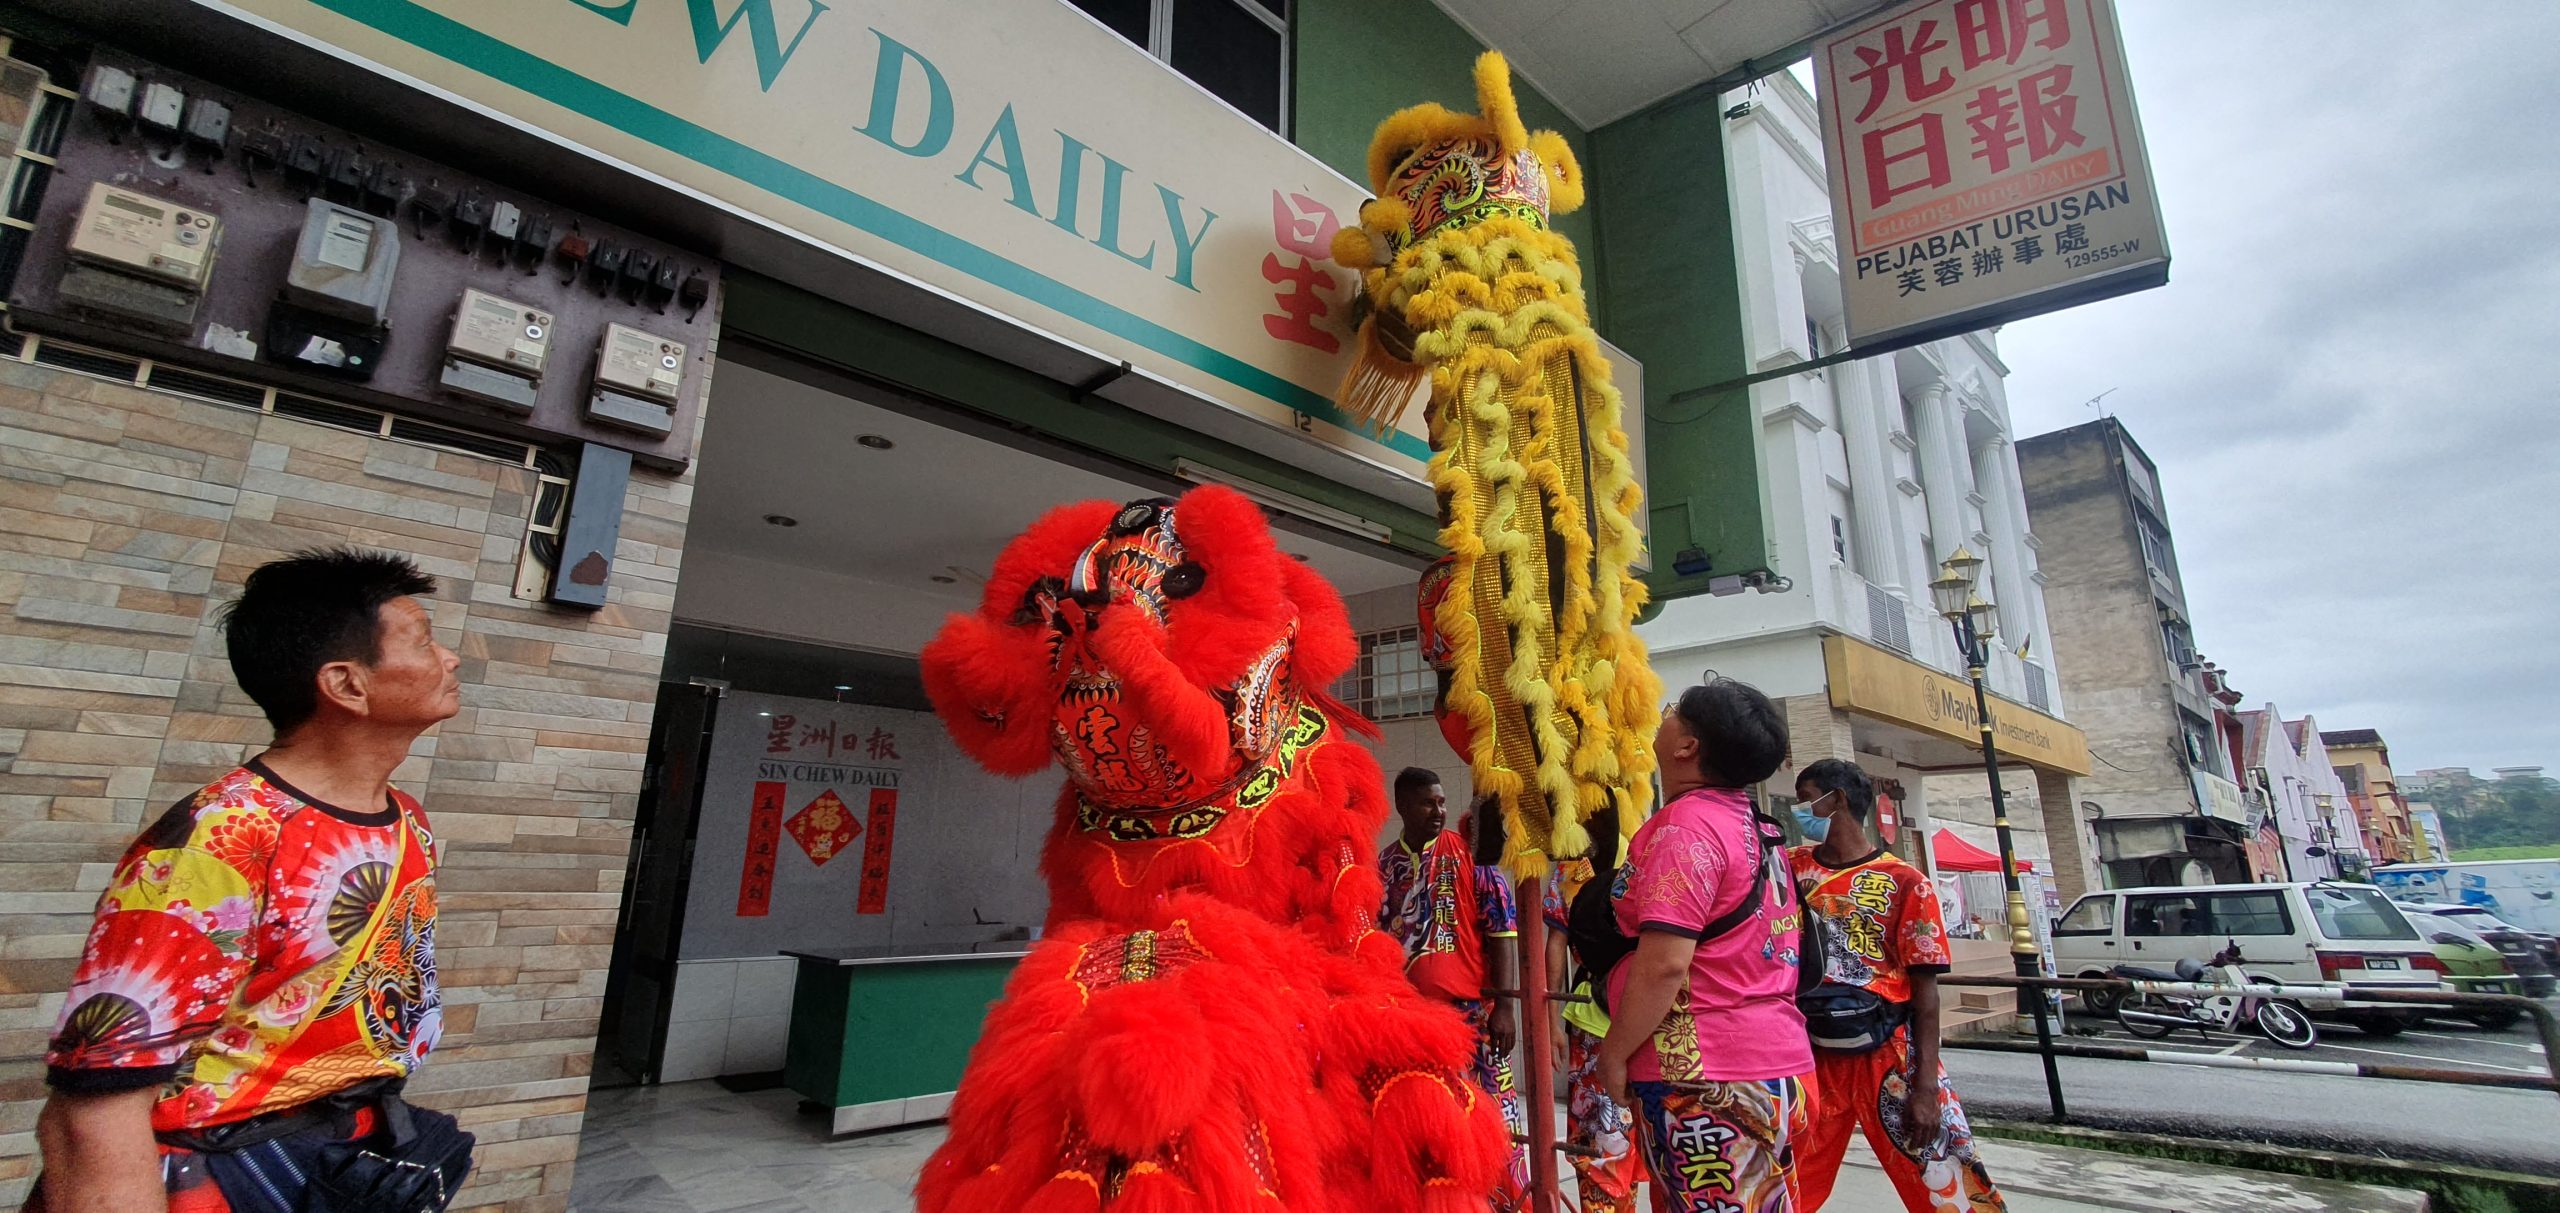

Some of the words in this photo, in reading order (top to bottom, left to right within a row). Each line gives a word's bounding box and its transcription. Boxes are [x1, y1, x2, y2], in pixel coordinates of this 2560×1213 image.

[1849, 0, 2072, 124] 光明
[852, 27, 1219, 293] DAILY
[1862, 64, 2086, 210] 日報
[1857, 222, 1984, 280] PEJABAT
[1992, 181, 2131, 240] URUSAN
[1872, 200, 1954, 238] Guang
[1958, 178, 2023, 213] Ming
[1261, 188, 1341, 355] 星
[1897, 222, 2090, 298] 芙蓉辦事處
[2064, 238, 2141, 270] 129555-W
[1293, 408, 1312, 432] 12
[766, 714, 901, 761] 星洲日報
[1941, 688, 2000, 734] Maybk
[1999, 716, 2035, 745] Investment
[2034, 728, 2052, 750] Bank
[758, 762, 789, 781] SIN
[793, 764, 851, 784] CHEW
[852, 768, 902, 788] DAILY
[1435, 870, 1459, 954] 雲龍館
[1842, 870, 1897, 960] 雲龍
[1671, 1117, 1741, 1213] 雲
